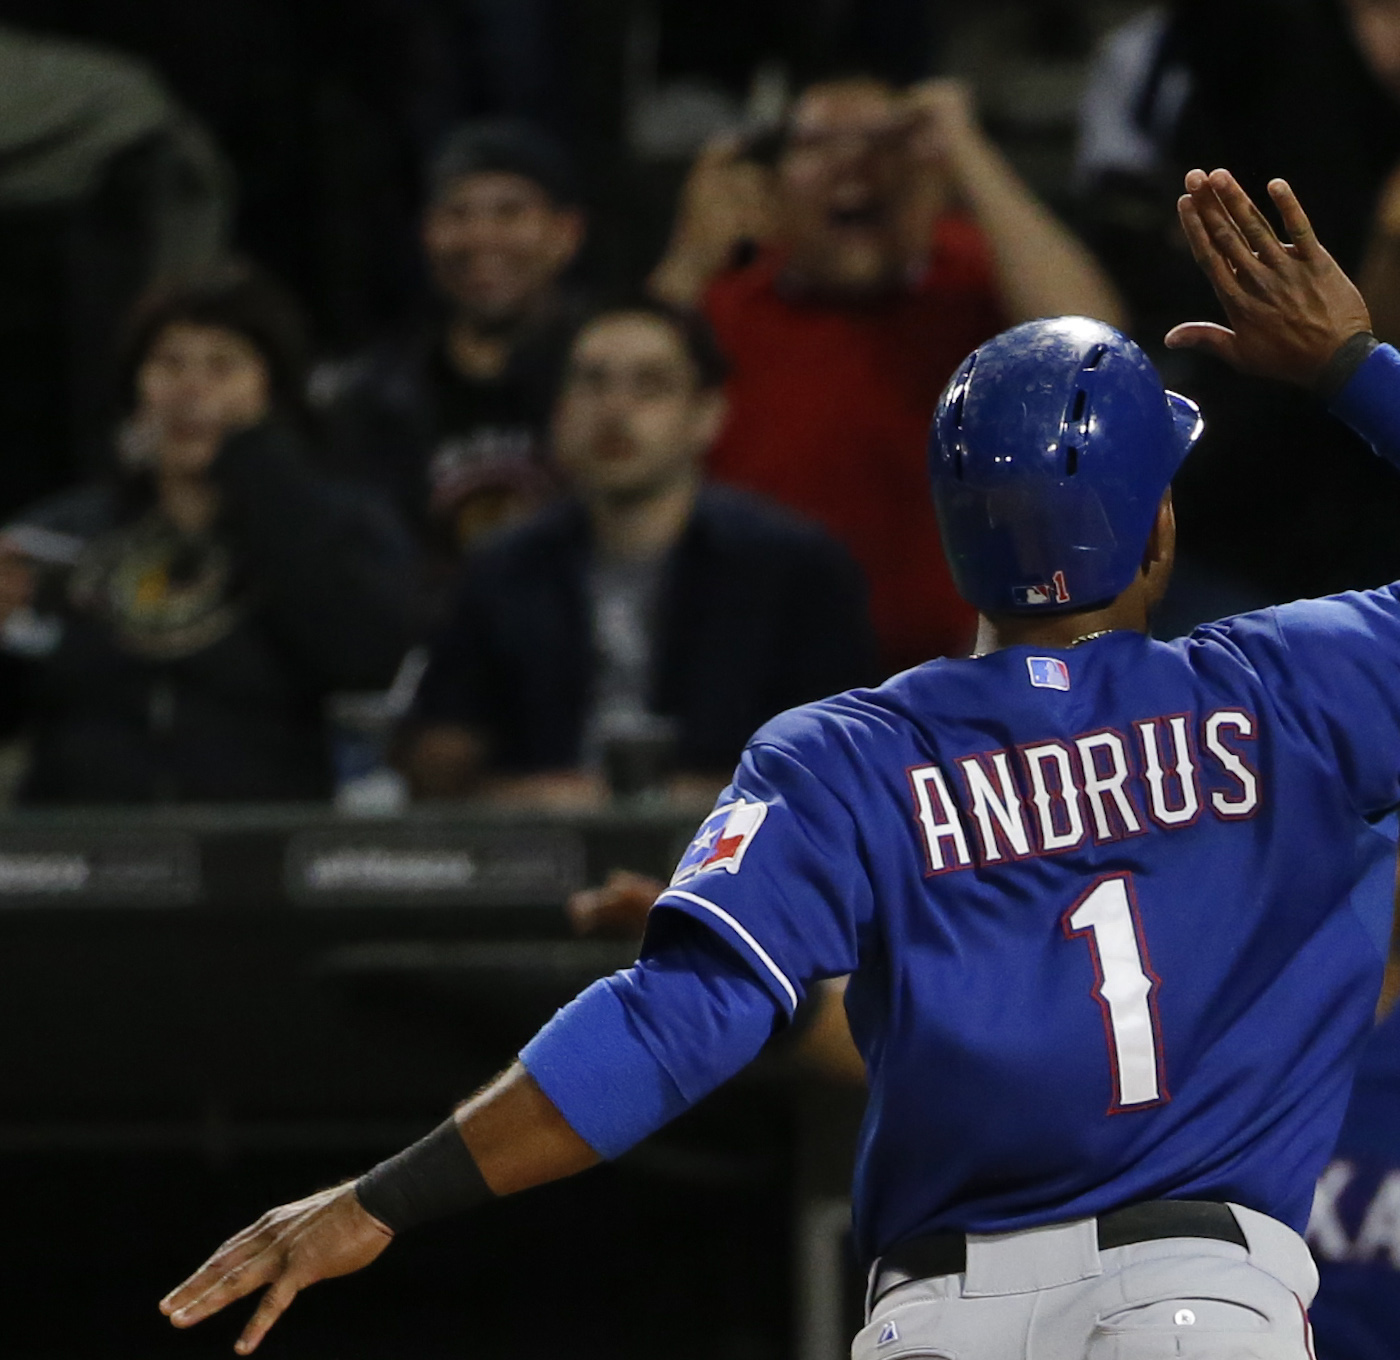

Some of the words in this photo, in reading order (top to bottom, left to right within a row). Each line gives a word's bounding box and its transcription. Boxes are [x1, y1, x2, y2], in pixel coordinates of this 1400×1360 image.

[1053, 571, 1070, 603] 1
[907, 708, 1260, 877] ANDRUS
[1063, 870, 1171, 1115] 1
